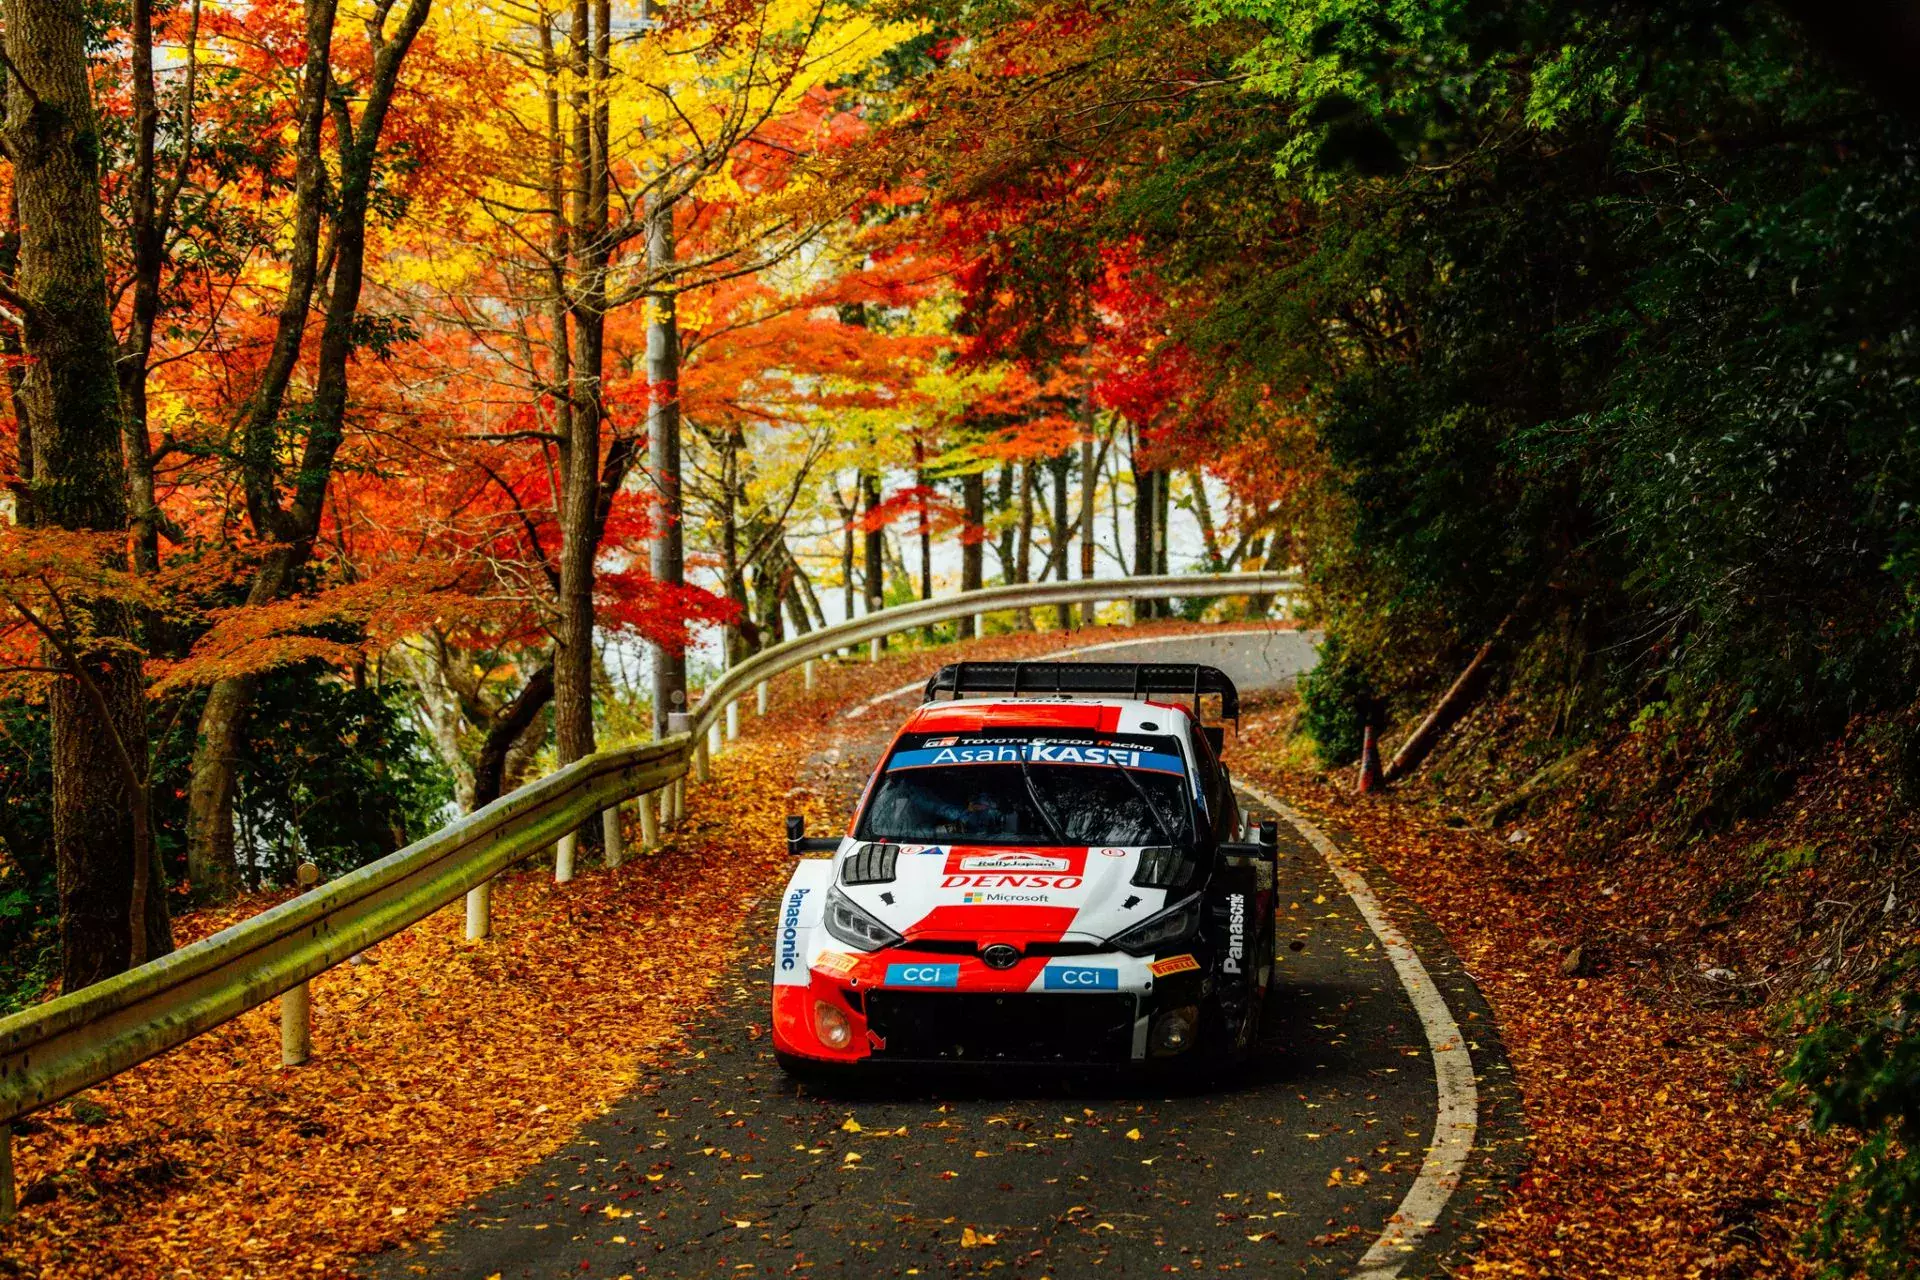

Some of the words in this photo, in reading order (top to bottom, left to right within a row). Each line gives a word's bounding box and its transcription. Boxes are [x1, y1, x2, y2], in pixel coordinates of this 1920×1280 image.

[1032, 737, 1094, 746] GAZOO
[1096, 739, 1155, 752] Racing
[940, 876, 1084, 890] DENSO
[986, 893, 1049, 903] Microsoft
[781, 888, 811, 972] Panasonic
[1223, 893, 1245, 975] Panasonic
